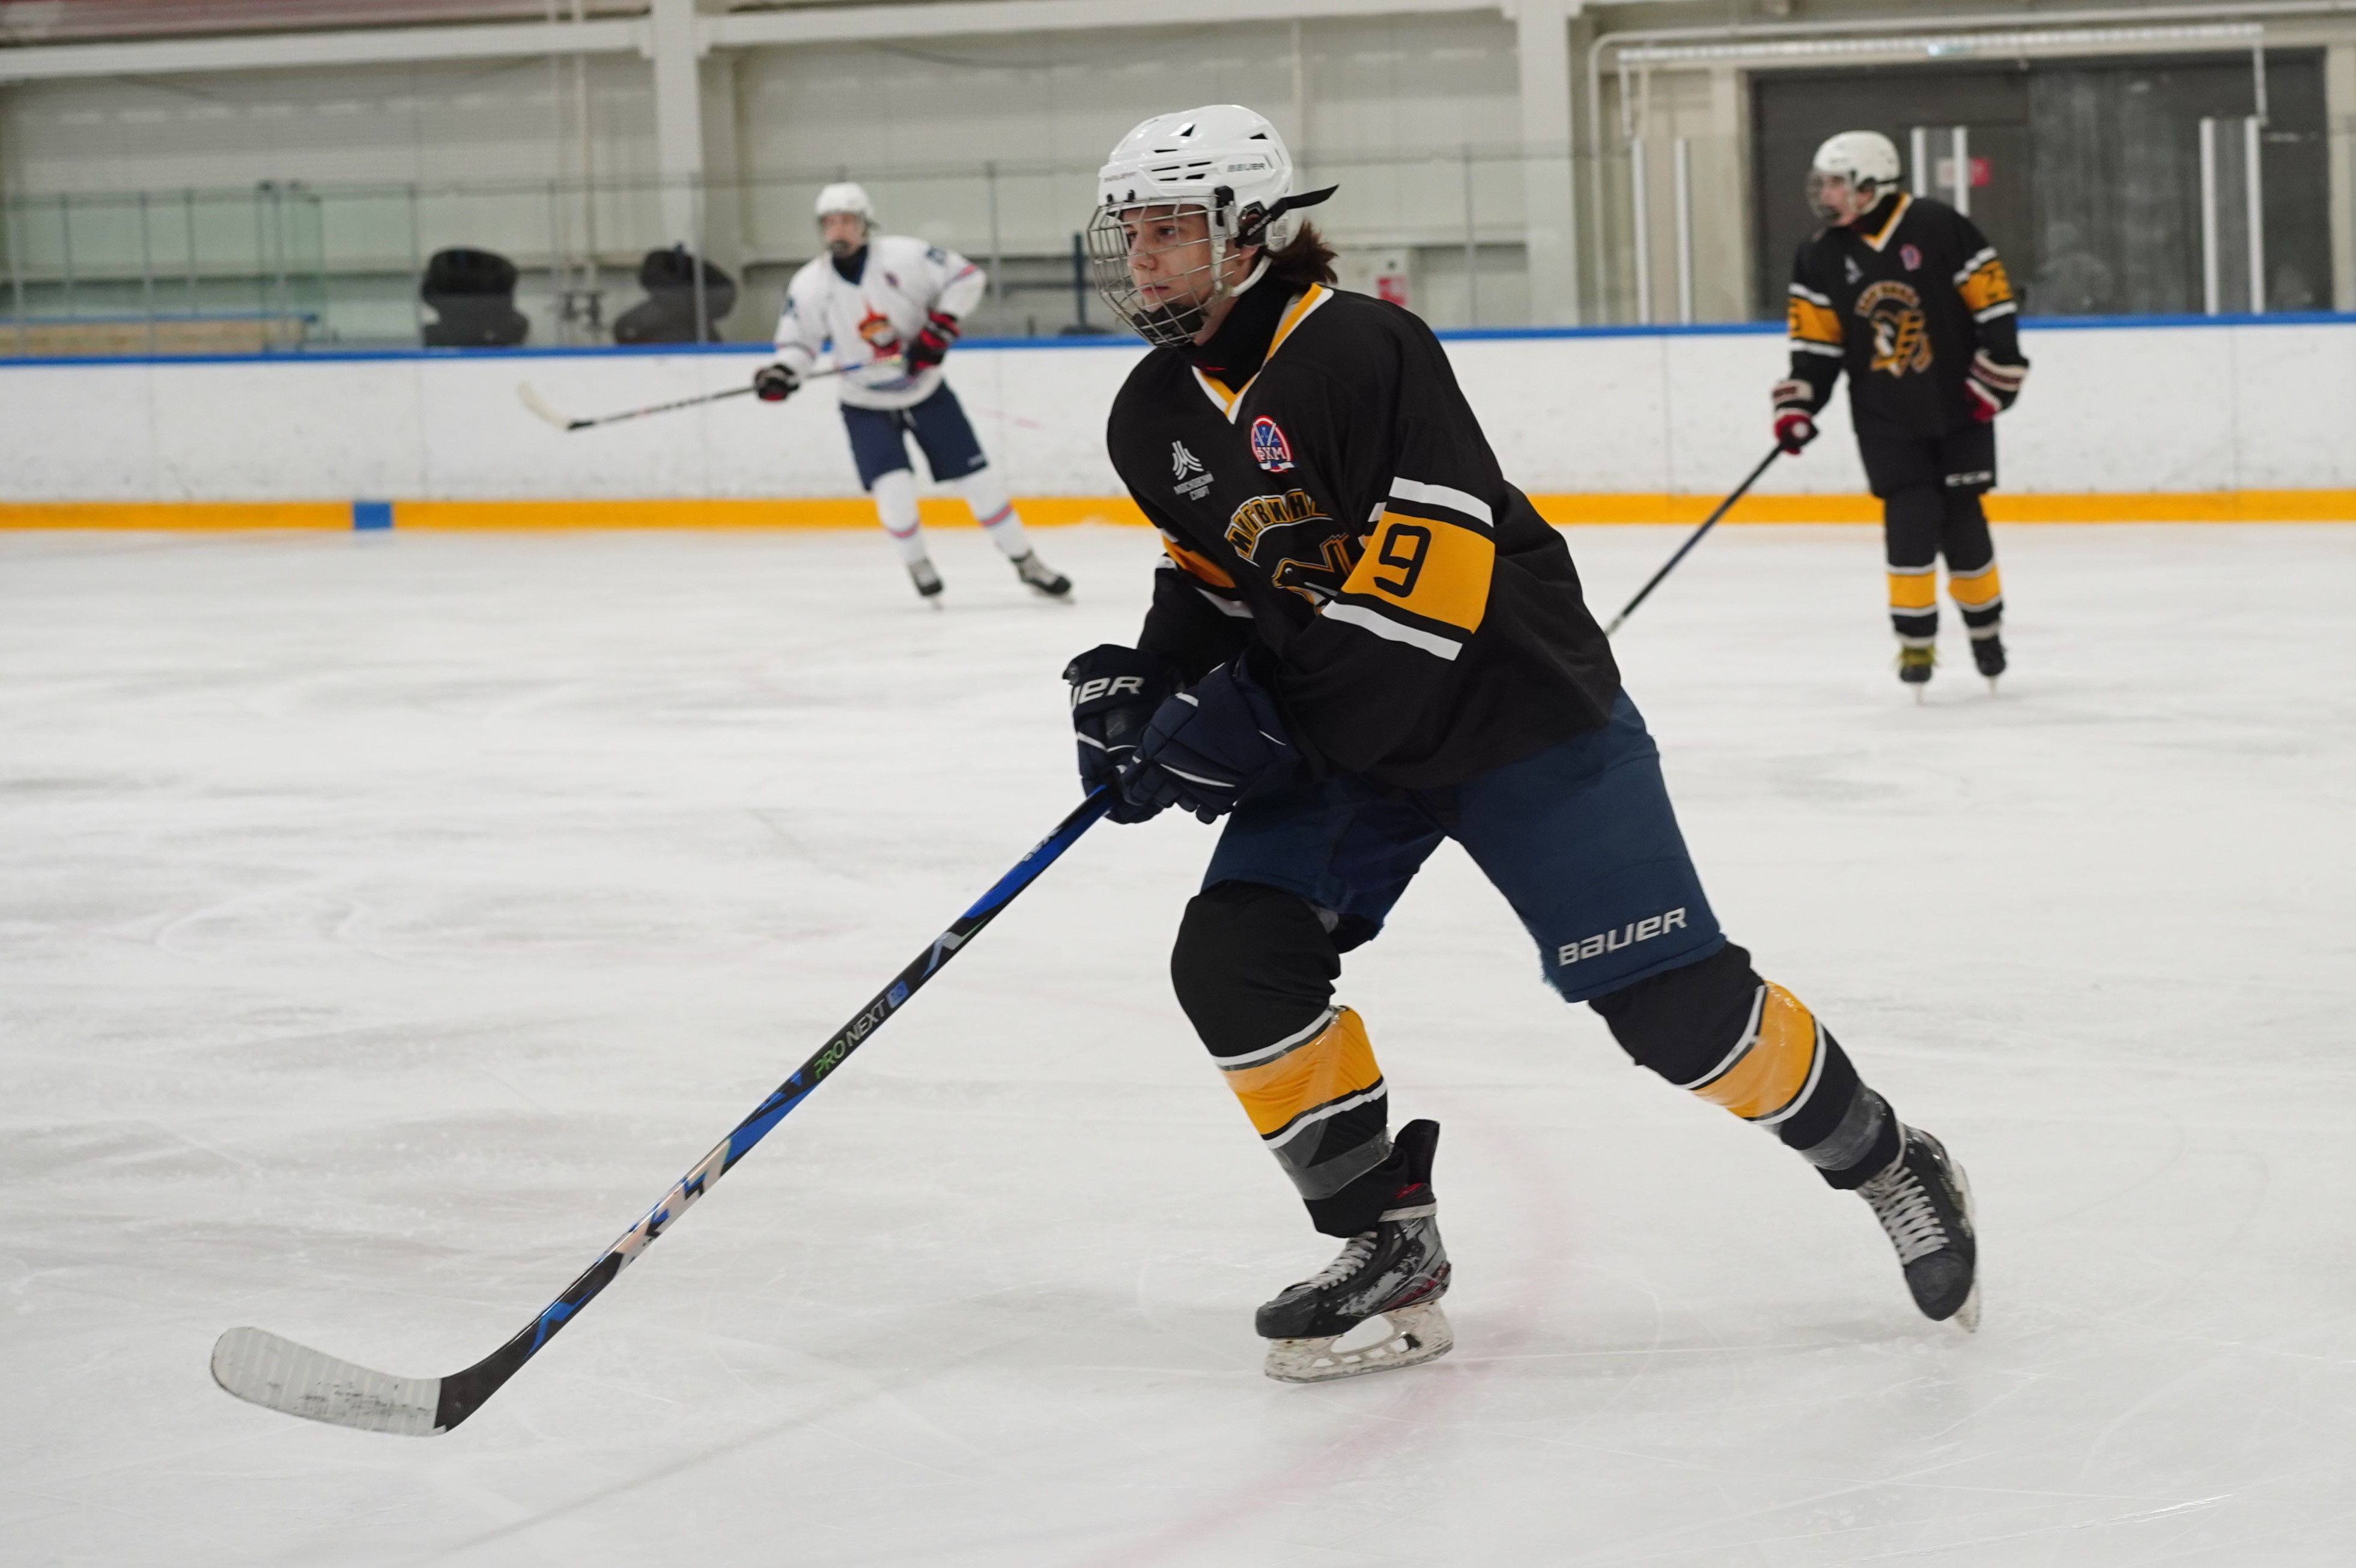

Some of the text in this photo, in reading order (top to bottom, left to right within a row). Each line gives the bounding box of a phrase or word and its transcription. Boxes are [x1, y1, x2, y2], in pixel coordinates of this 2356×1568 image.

[1373, 522, 1432, 598] 9
[813, 997, 885, 1079] PRO NEXT
